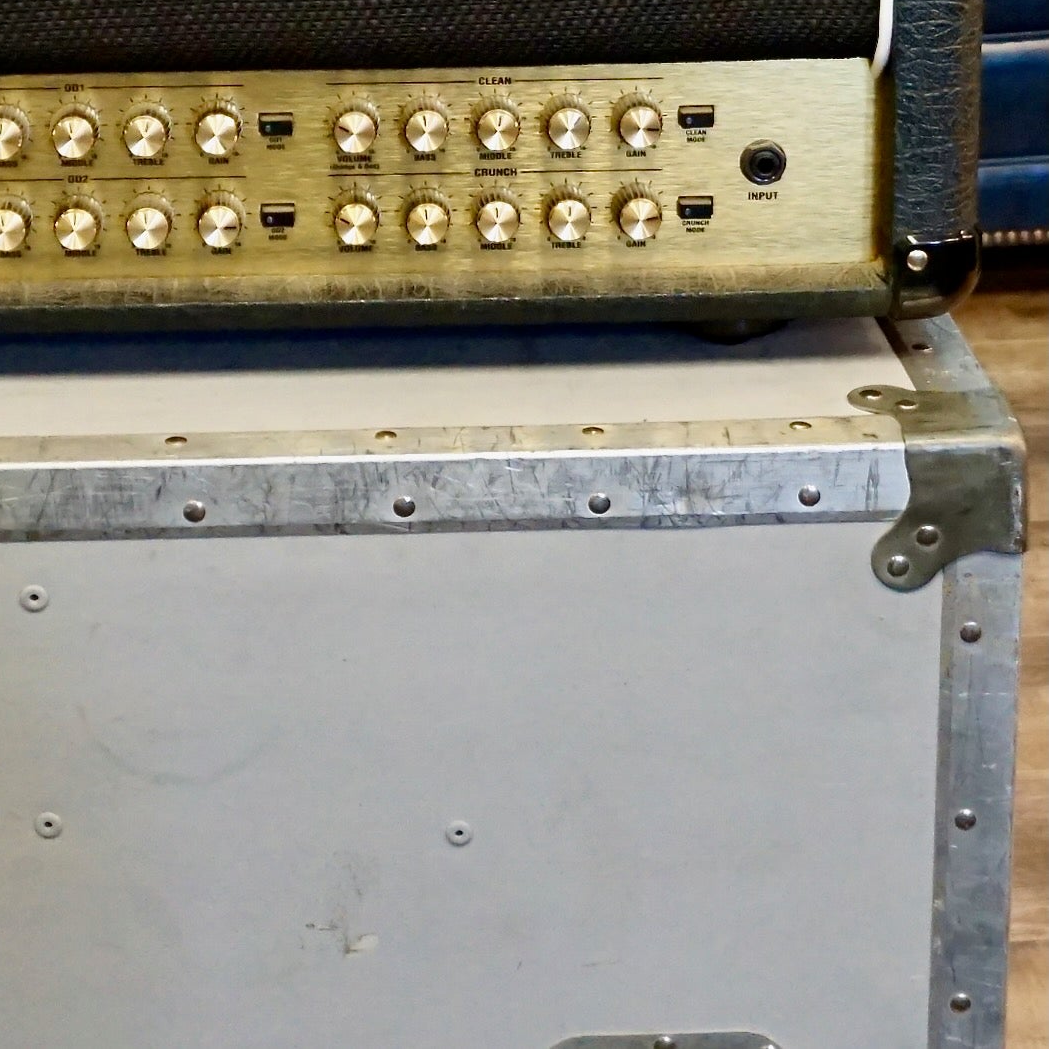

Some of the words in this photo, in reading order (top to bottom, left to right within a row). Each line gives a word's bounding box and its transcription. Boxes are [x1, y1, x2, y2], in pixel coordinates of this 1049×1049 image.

[478, 76, 512, 85] CLEAN
[479, 152, 512, 160] MIDDLE
[550, 151, 582, 159] TREBLE
[625, 150, 647, 158] GAIN
[474, 168, 518, 178] CRUNCH
[747, 191, 779, 201] INPUT
[626, 240, 647, 248] GAIN
